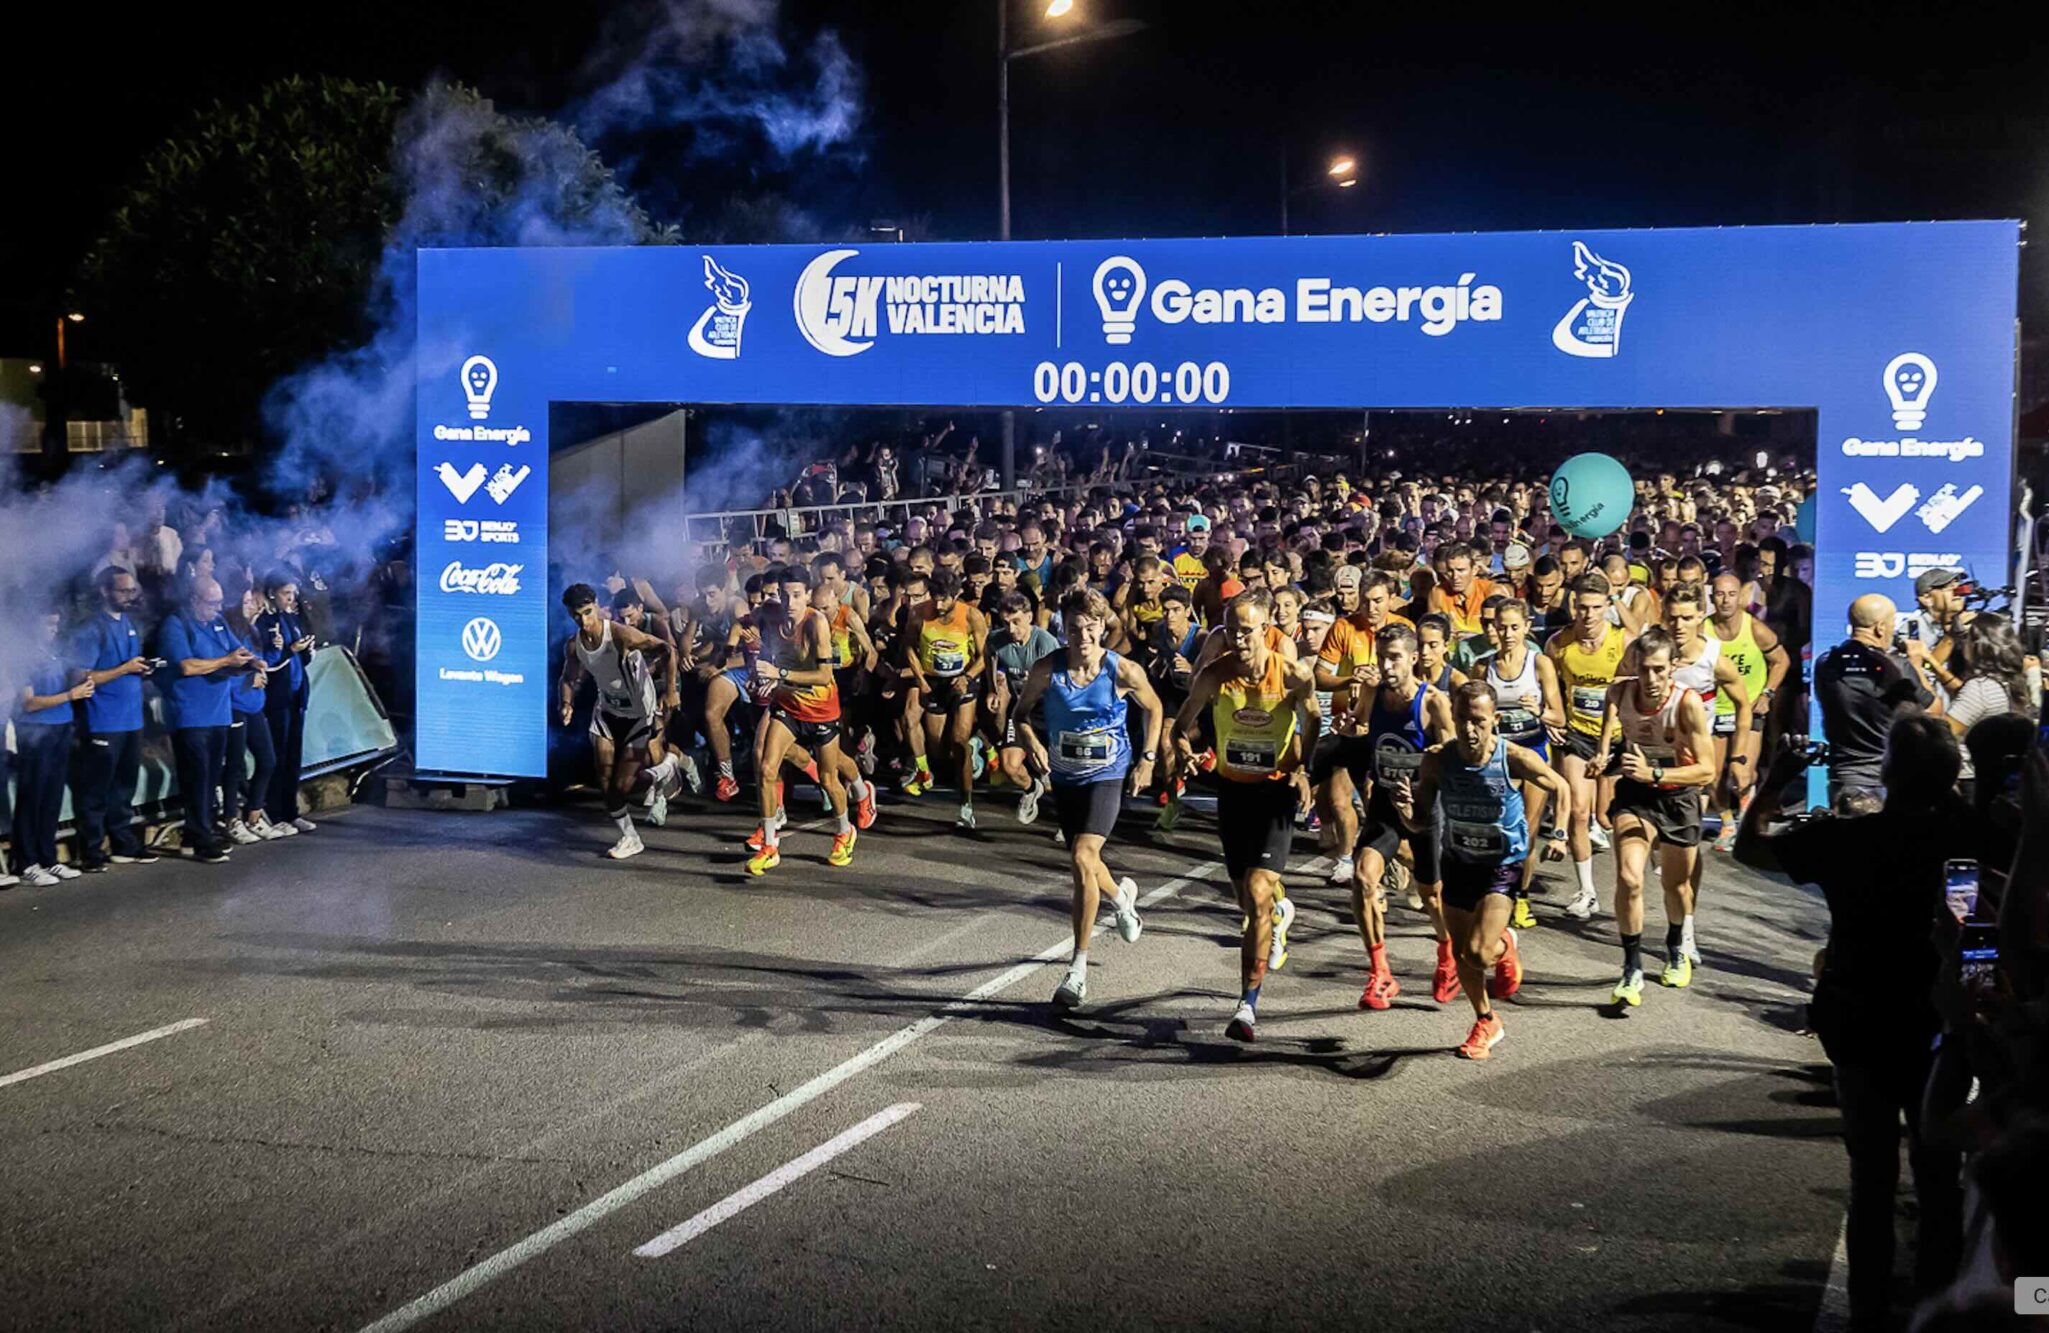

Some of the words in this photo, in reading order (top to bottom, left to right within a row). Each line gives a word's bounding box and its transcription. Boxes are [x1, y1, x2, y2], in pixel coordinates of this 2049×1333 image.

[886, 275, 1025, 303] NOCTURNA
[1151, 279, 1286, 324] Gana
[1296, 272, 1503, 337] Energía
[886, 303, 1025, 334] VALENCIA
[1034, 361, 1230, 404] 00:00:00
[1462, 836, 1489, 848] 202
